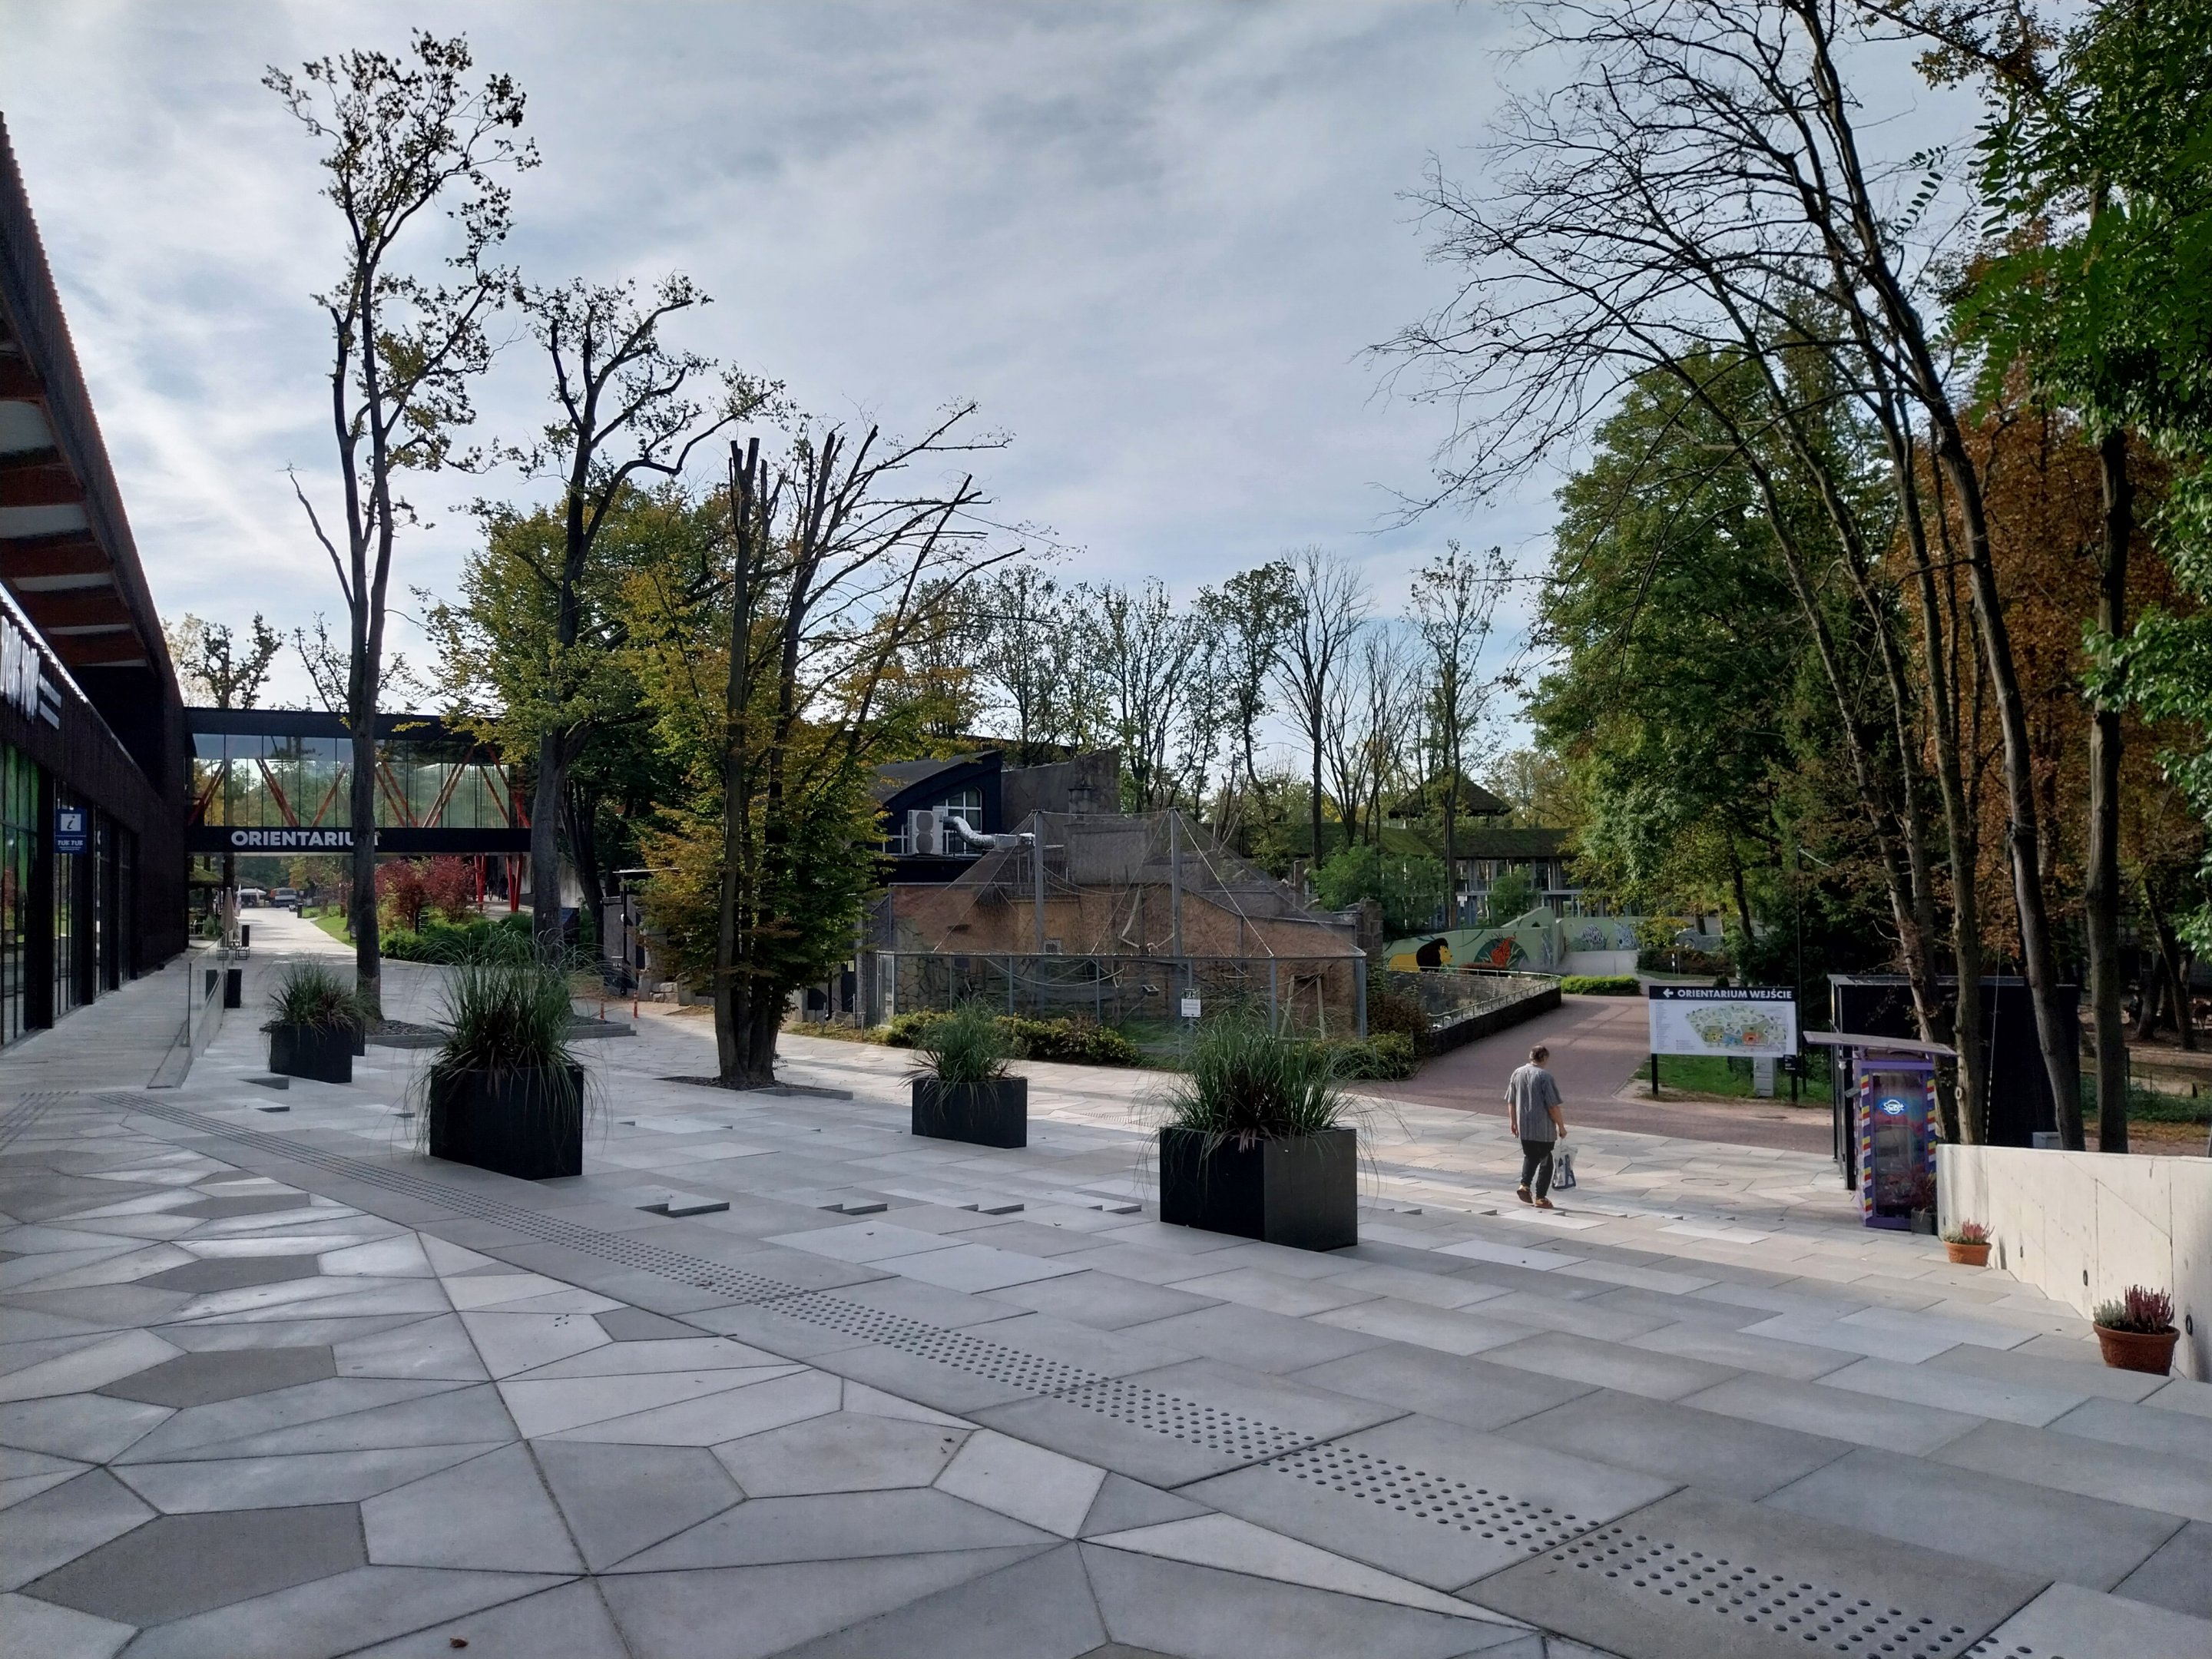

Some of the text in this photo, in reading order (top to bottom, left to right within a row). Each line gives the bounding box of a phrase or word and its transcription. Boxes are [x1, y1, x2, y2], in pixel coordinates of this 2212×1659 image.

[231, 830, 379, 846] ORIENTARIU
[1677, 988, 1792, 998] ORIENTARIUM WEJŚCIE
